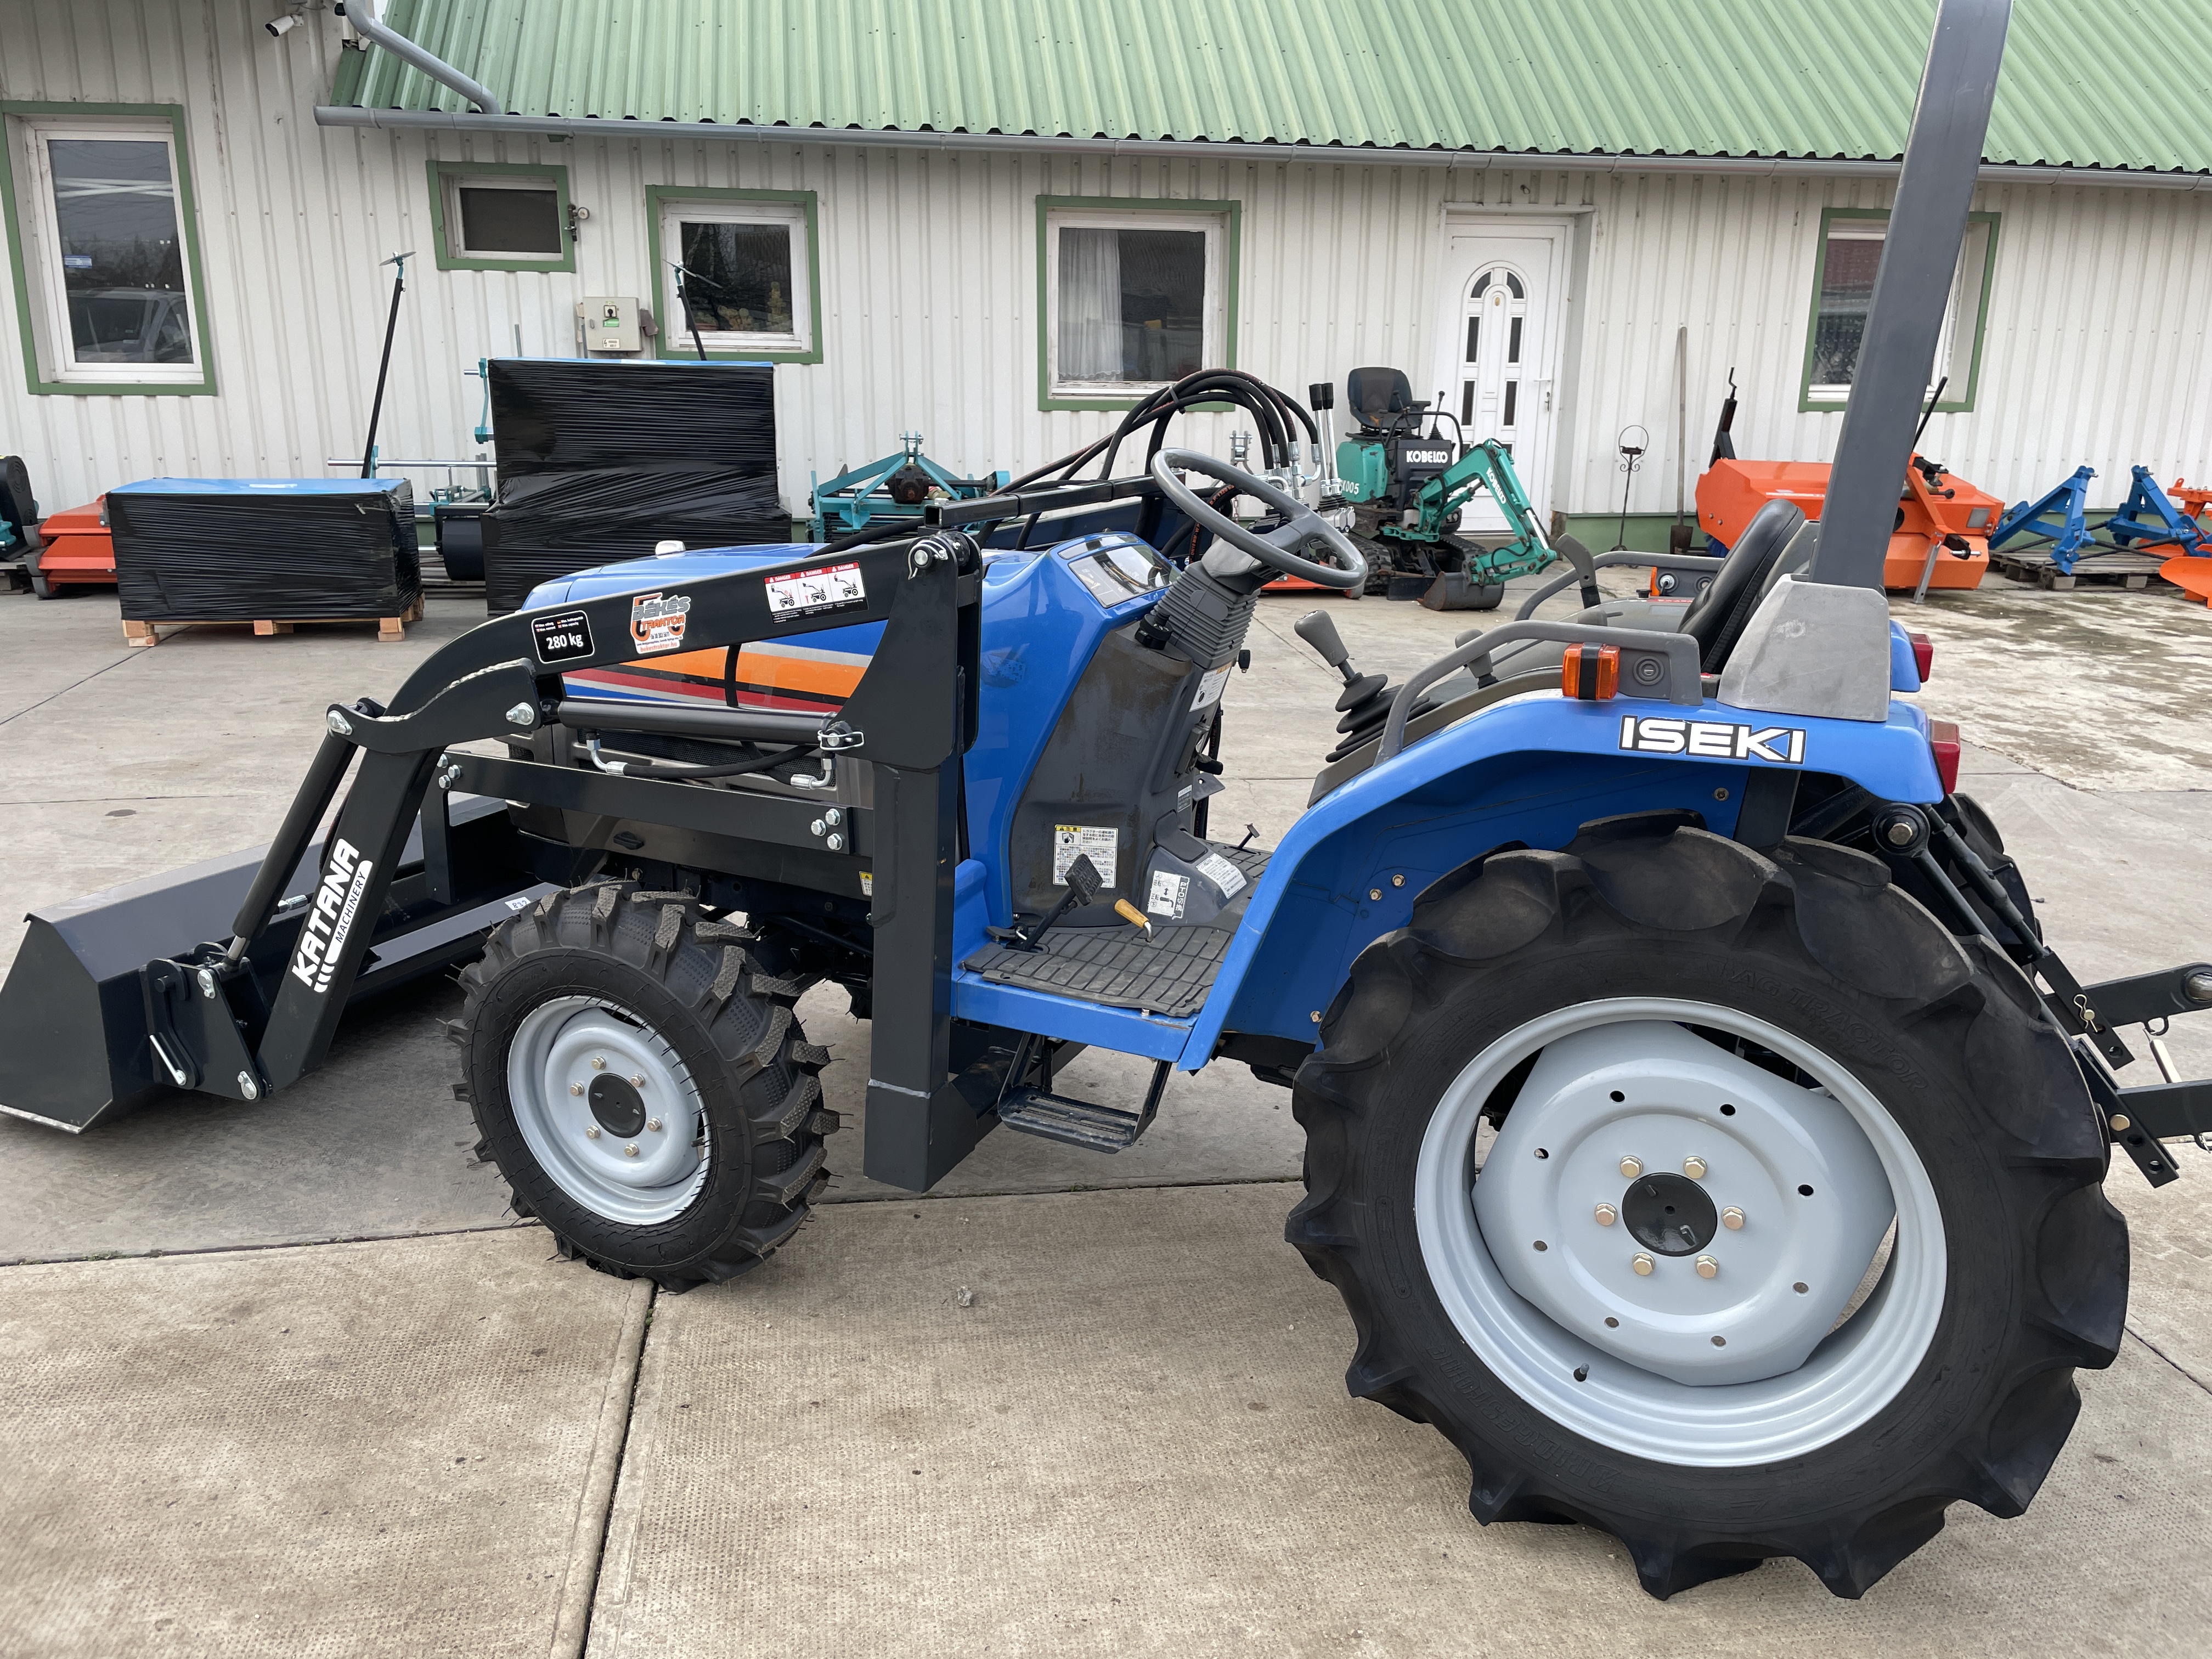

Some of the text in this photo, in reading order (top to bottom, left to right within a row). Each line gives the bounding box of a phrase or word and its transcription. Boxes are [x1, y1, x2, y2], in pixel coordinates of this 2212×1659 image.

[1406, 450, 1448, 463] KOBELCO
[1486, 467, 1506, 504] KOBELCO
[633, 596, 690, 620] BÉKÉS
[641, 614, 685, 630] TRAKTOR
[546, 633, 584, 650] 280 kg
[1620, 715, 1806, 763] ISEKI
[292, 838, 359, 987] KATANA
[335, 871, 366, 943] MACHINERY
